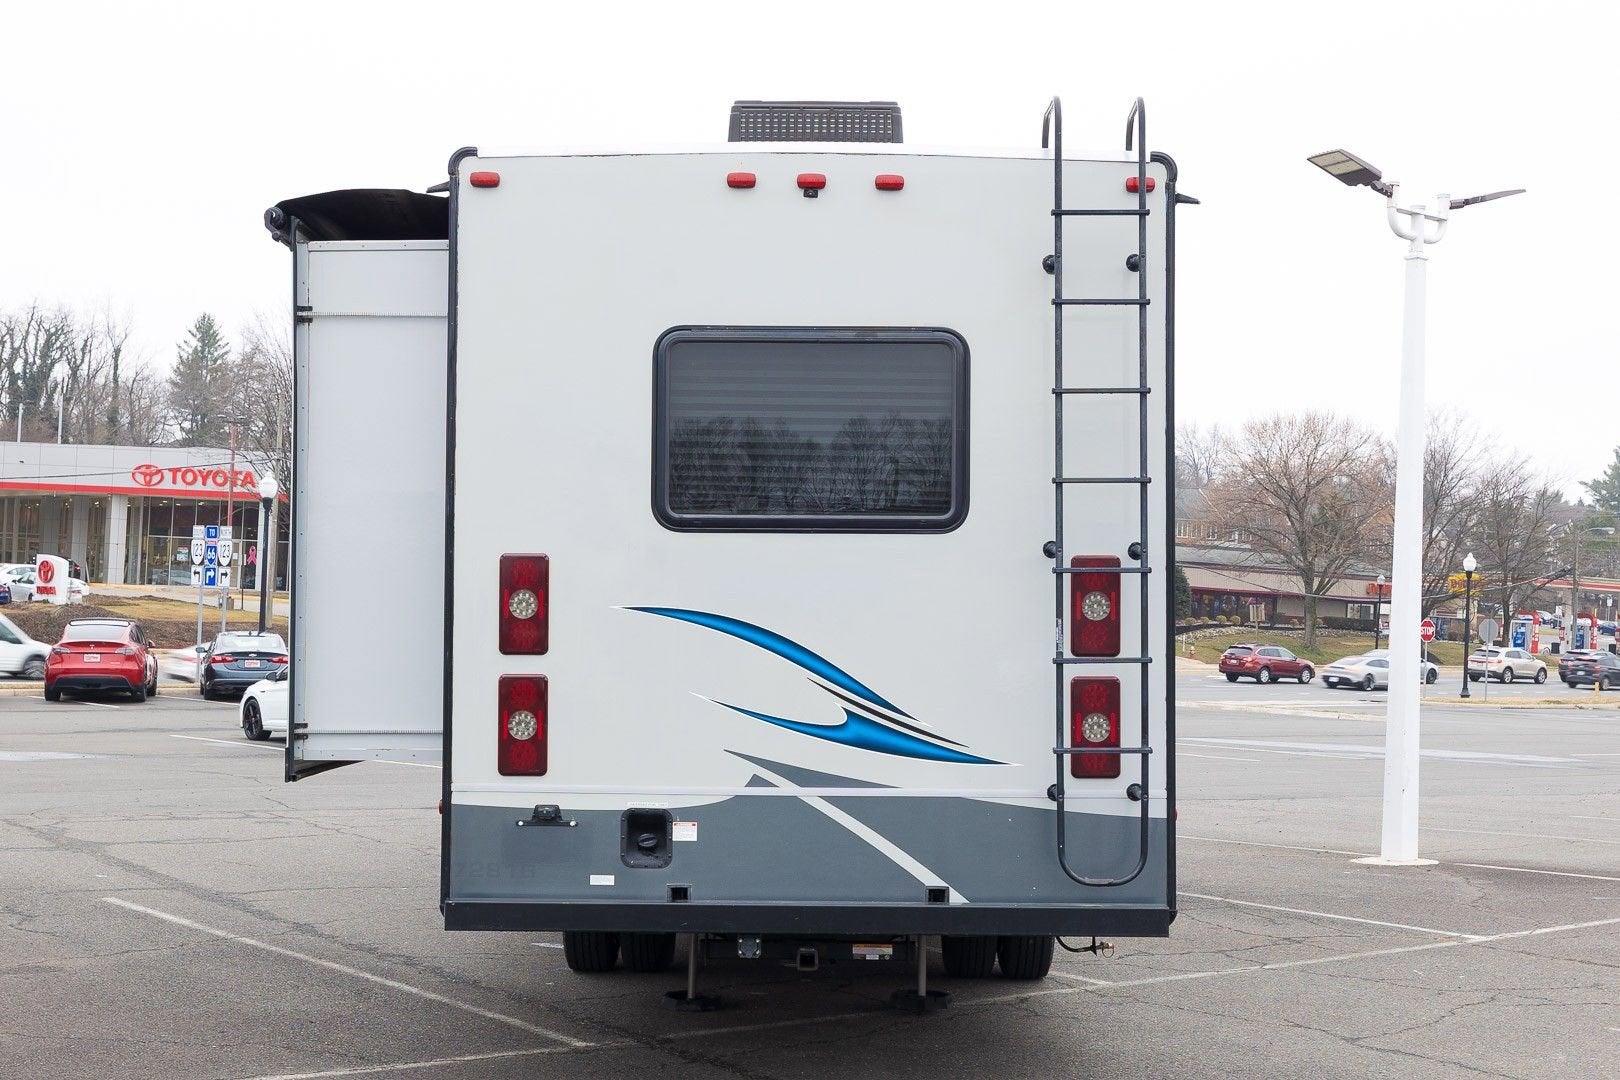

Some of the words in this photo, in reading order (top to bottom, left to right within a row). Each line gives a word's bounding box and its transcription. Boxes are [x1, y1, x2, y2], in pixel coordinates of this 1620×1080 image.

[168, 467, 256, 488] TOYOTA
[207, 547, 216, 560] 66
[220, 544, 231, 558] 123
[1420, 626, 1435, 636] STOP
